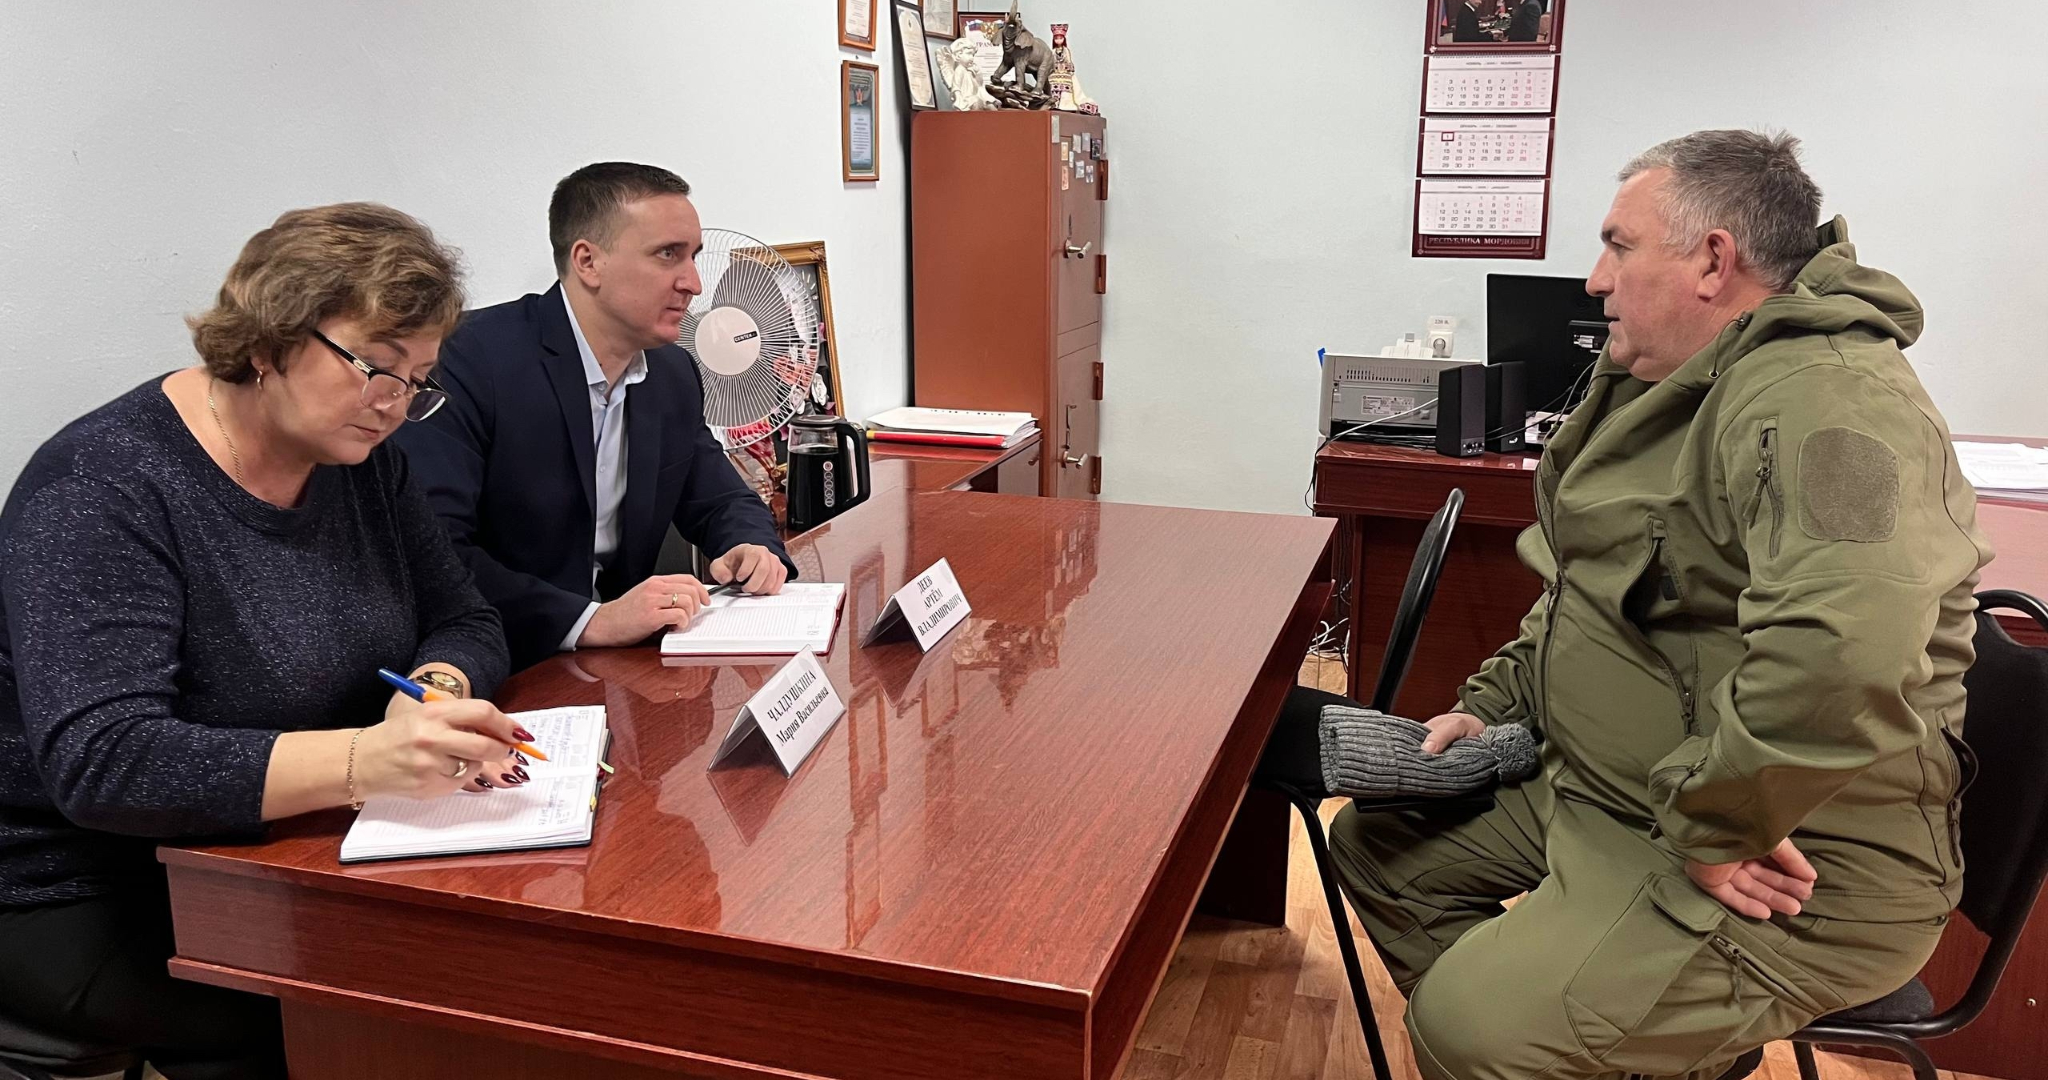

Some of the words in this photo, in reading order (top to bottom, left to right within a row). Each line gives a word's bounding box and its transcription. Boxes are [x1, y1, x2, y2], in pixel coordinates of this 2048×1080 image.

[917, 575, 933, 594] ДЕЕВ
[924, 588, 944, 610] АРТЁМ
[767, 669, 817, 722] ЧАЛДУШКИНА
[776, 719, 801, 746] Мария
[795, 686, 829, 724] Васильевна
